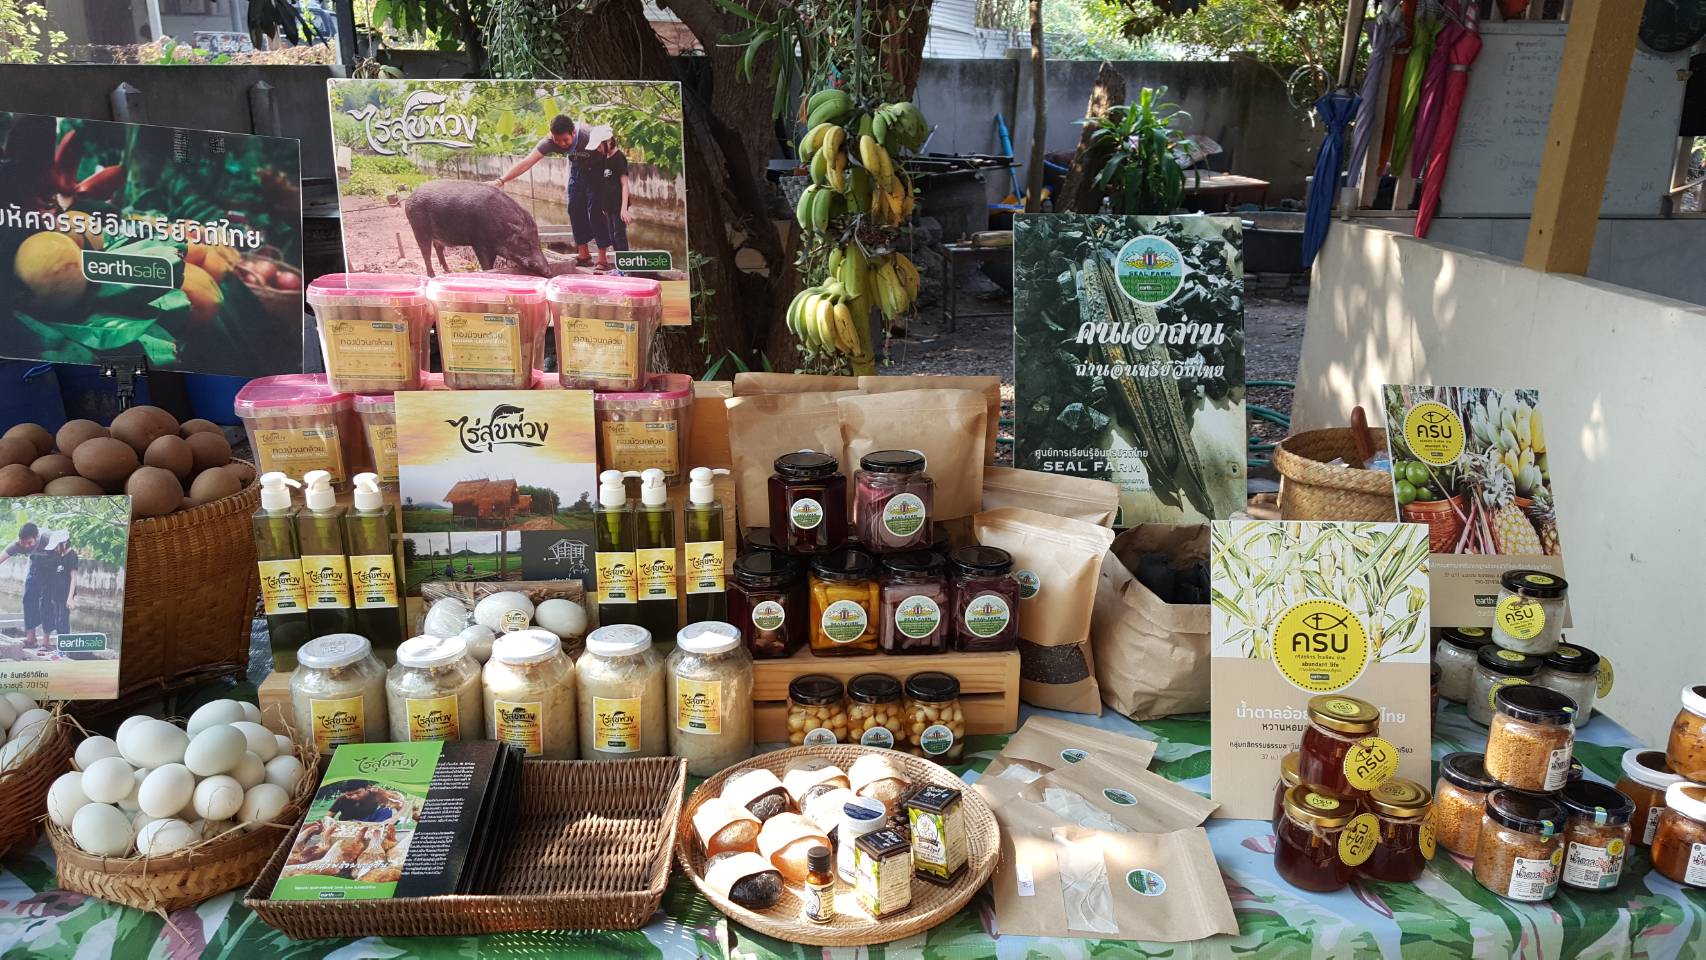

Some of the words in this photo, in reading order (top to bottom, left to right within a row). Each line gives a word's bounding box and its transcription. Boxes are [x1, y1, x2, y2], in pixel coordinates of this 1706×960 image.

[618, 255, 668, 267] earthsafe
[87, 259, 167, 280] earthsafe
[445, 404, 549, 453] ไร่สุขพ่วง
[1417, 424, 1452, 438] ครบ
[1043, 461, 1088, 472] SEAL
[1093, 461, 1141, 473] FARM
[1505, 608, 1533, 623] ครบ
[59, 637, 103, 648] earthsafe
[1292, 632, 1348, 653] ครบ
[1262, 723, 1307, 733] หวานหอม
[1357, 749, 1386, 778] ครบ
